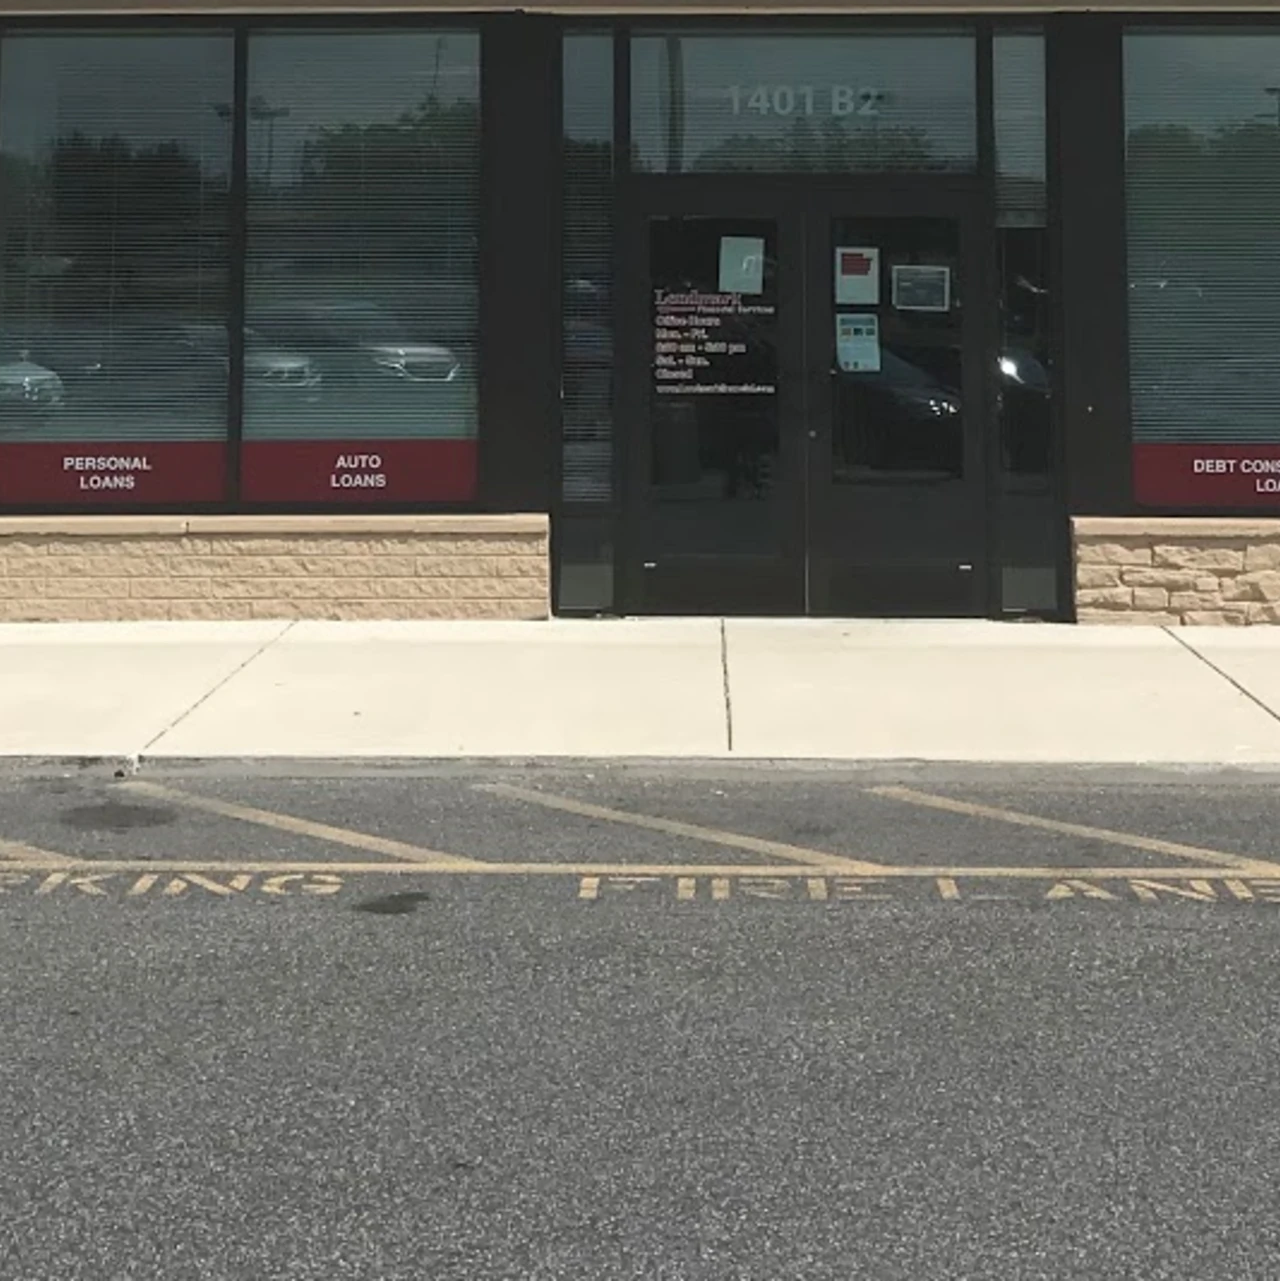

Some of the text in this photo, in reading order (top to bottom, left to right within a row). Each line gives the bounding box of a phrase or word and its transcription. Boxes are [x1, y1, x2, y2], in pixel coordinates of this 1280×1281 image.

[729, 85, 880, 116] 1401 B2
[63, 457, 152, 470] PERSONAL
[336, 455, 382, 468] AUTO
[1193, 460, 1236, 473] DEBT
[80, 475, 135, 489] LOANS
[330, 474, 387, 487] LOANS
[578, 876, 894, 900] FIRE
